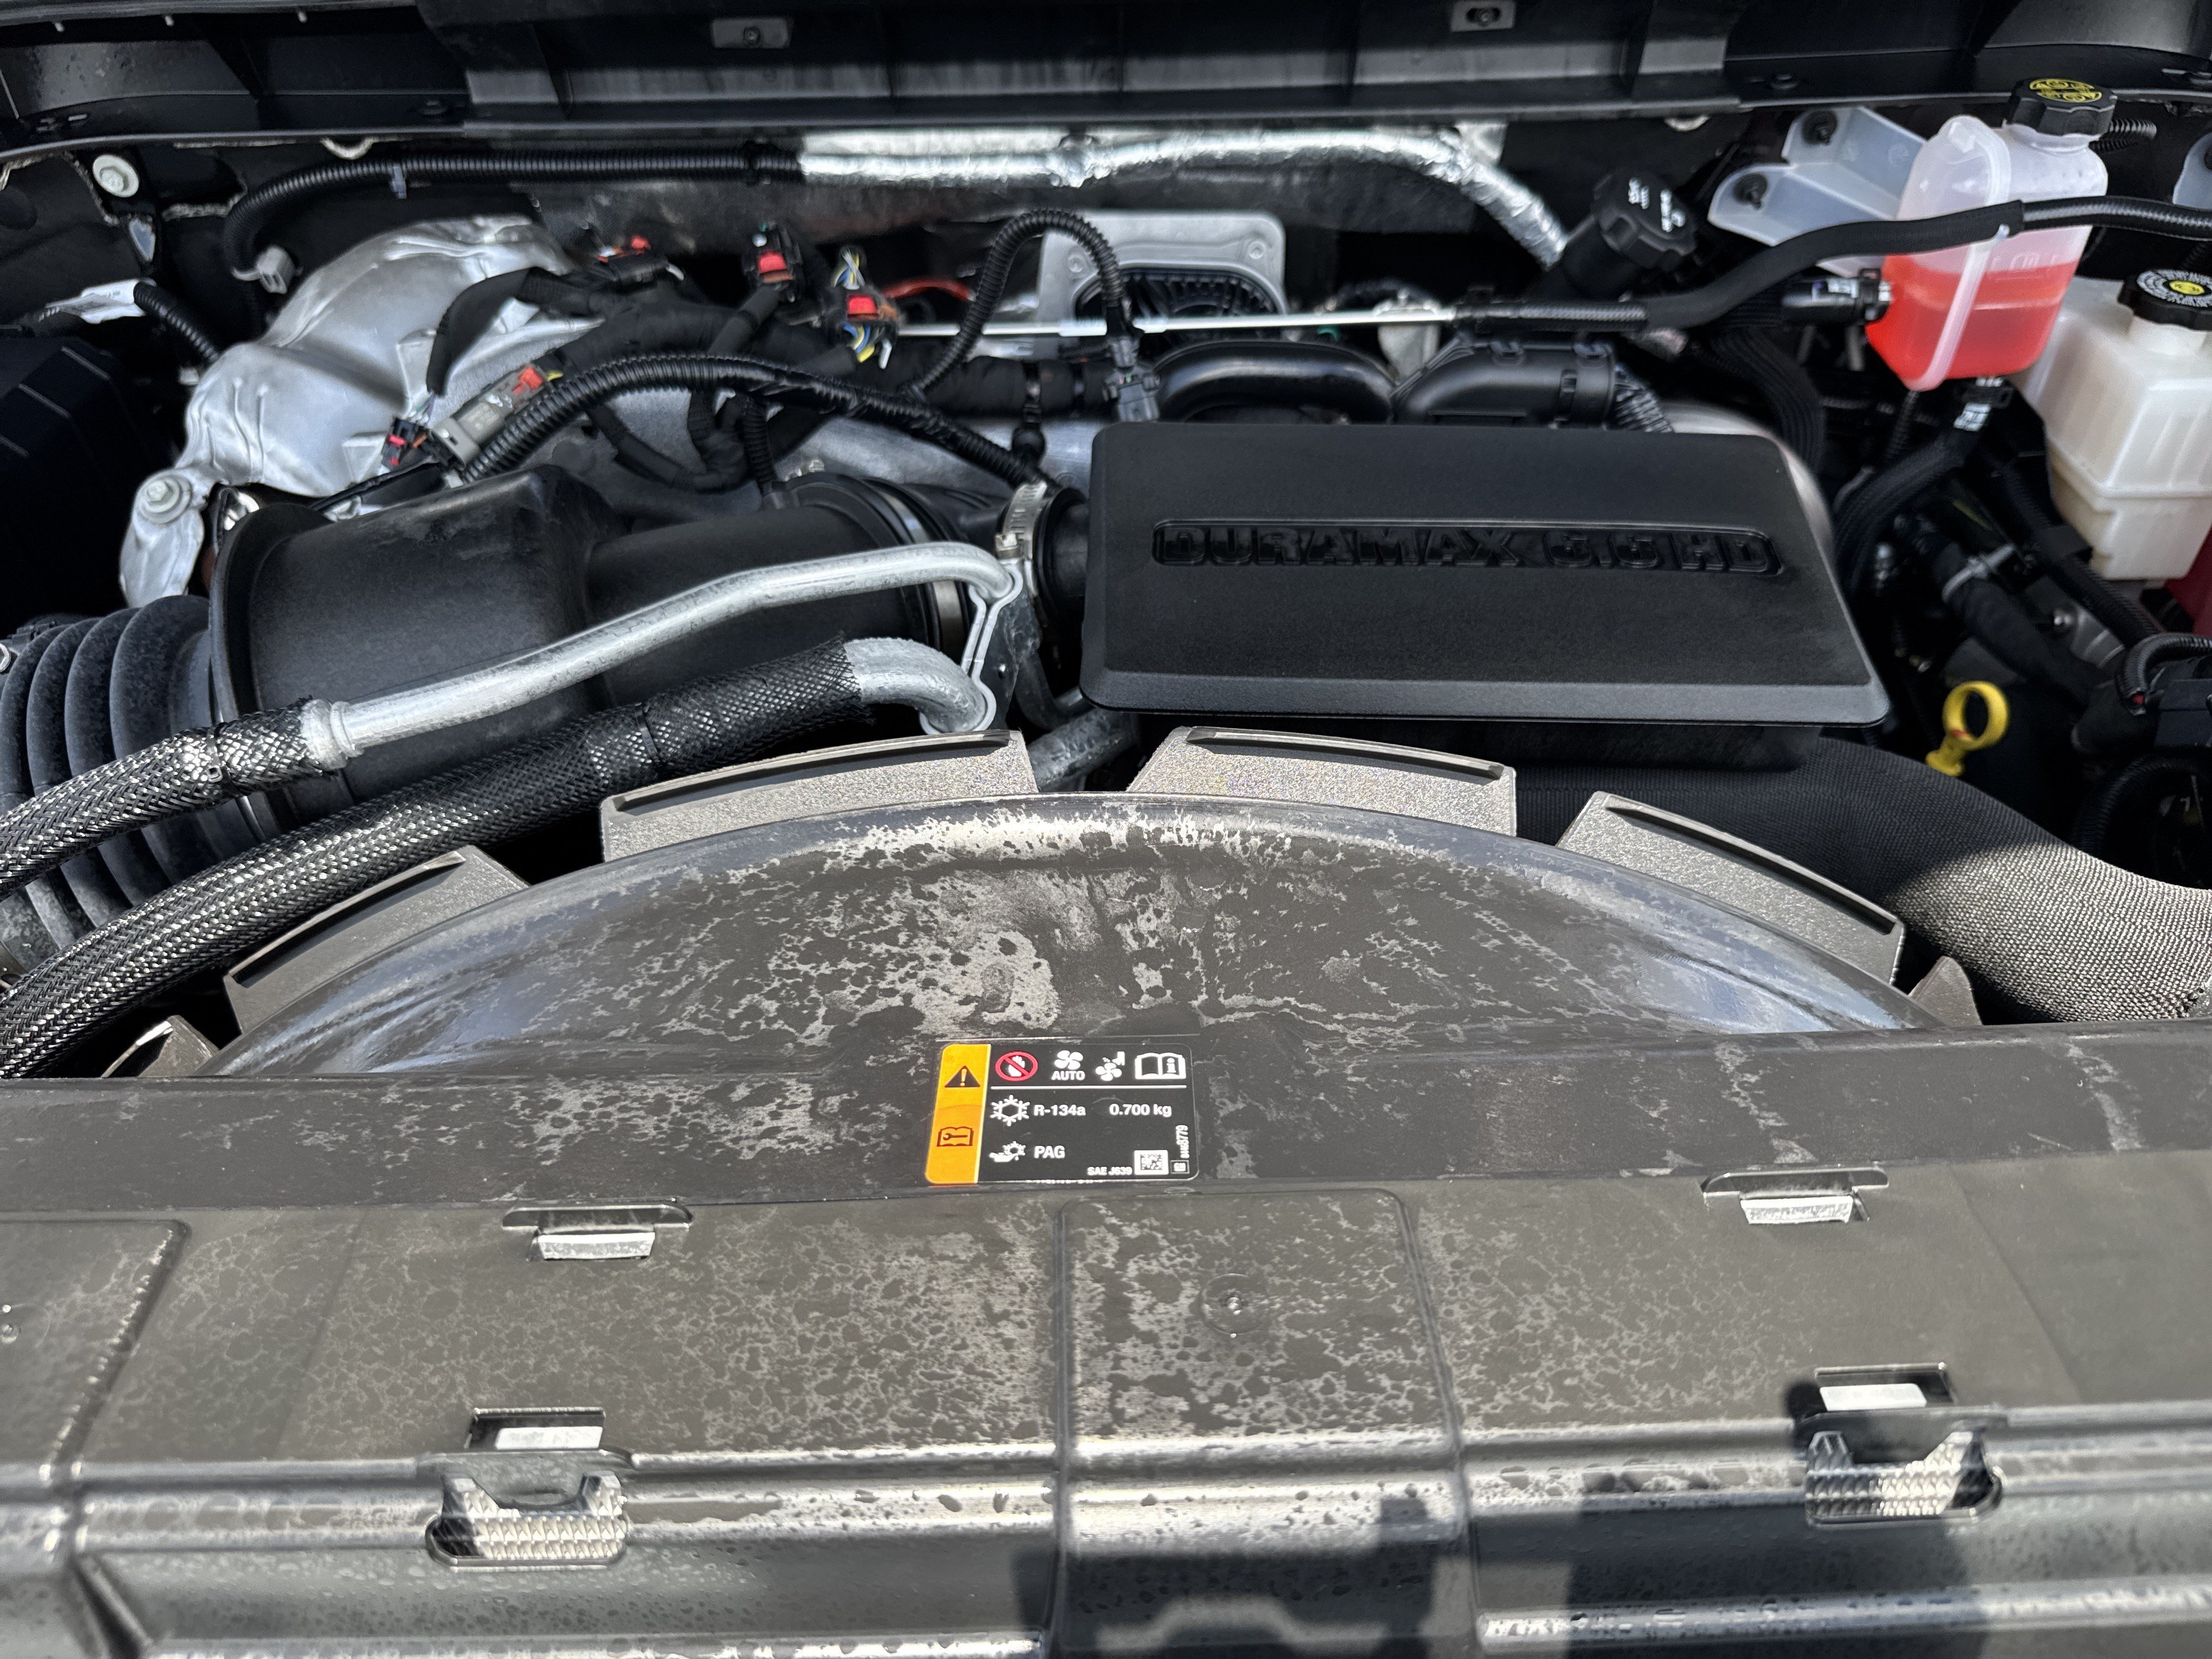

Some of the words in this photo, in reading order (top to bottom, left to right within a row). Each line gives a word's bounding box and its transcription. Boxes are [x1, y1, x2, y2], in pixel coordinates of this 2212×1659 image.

[1160, 527, 1520, 566] DURAMAX
[1669, 534, 1769, 572] HD
[1051, 1070, 1085, 1081] AUTO
[1034, 1104, 1086, 1116] R-134a
[1109, 1104, 1150, 1116] 0.700
[1153, 1104, 1172, 1118] kg
[1034, 1145, 1065, 1159] PAG
[1087, 1166, 1107, 1176] SAE
[1108, 1166, 1132, 1176] J639
